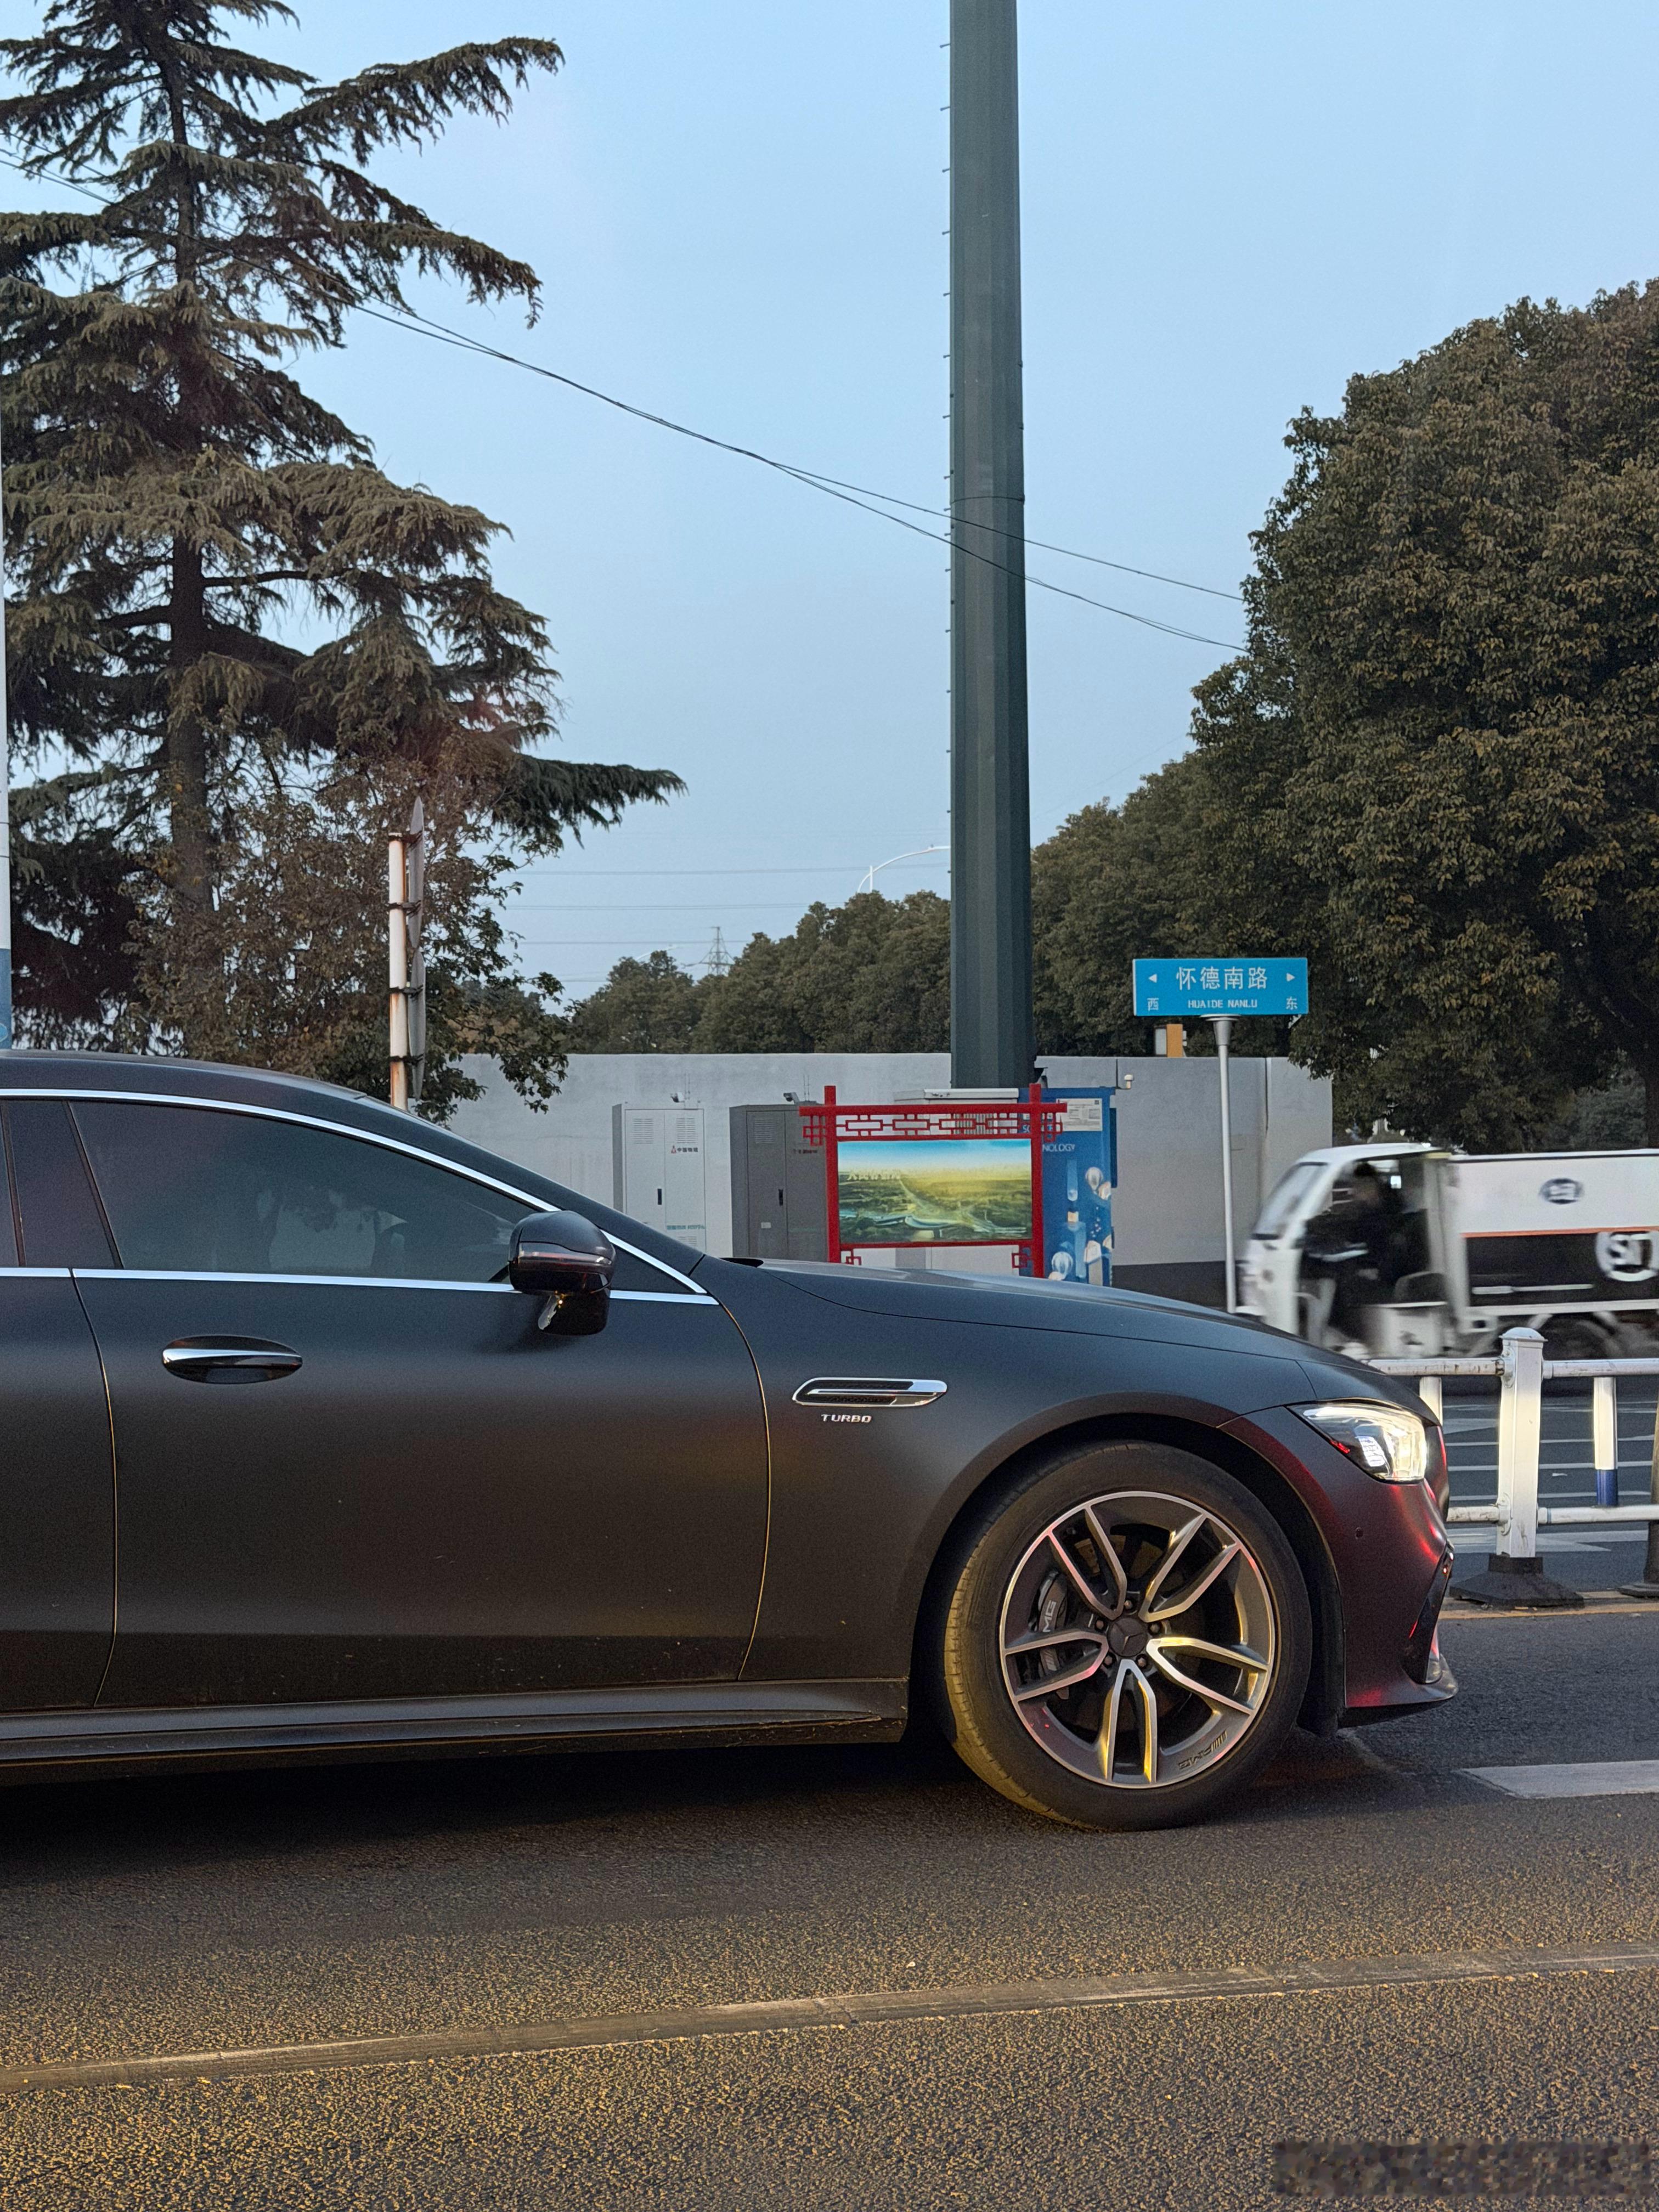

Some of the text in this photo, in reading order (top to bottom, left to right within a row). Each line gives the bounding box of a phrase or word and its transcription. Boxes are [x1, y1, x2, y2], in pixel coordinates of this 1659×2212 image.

[1176, 966, 1268, 990] 怀德南路
[1147, 997, 1159, 1011] 西
[1188, 999, 1258, 1008] HUAIDE NANLU
[1286, 997, 1299, 1011] 东
[1042, 1143, 1075, 1152] NOLOGY
[821, 1414, 872, 1423] TURBO
[1042, 1600, 1057, 1632] MG
